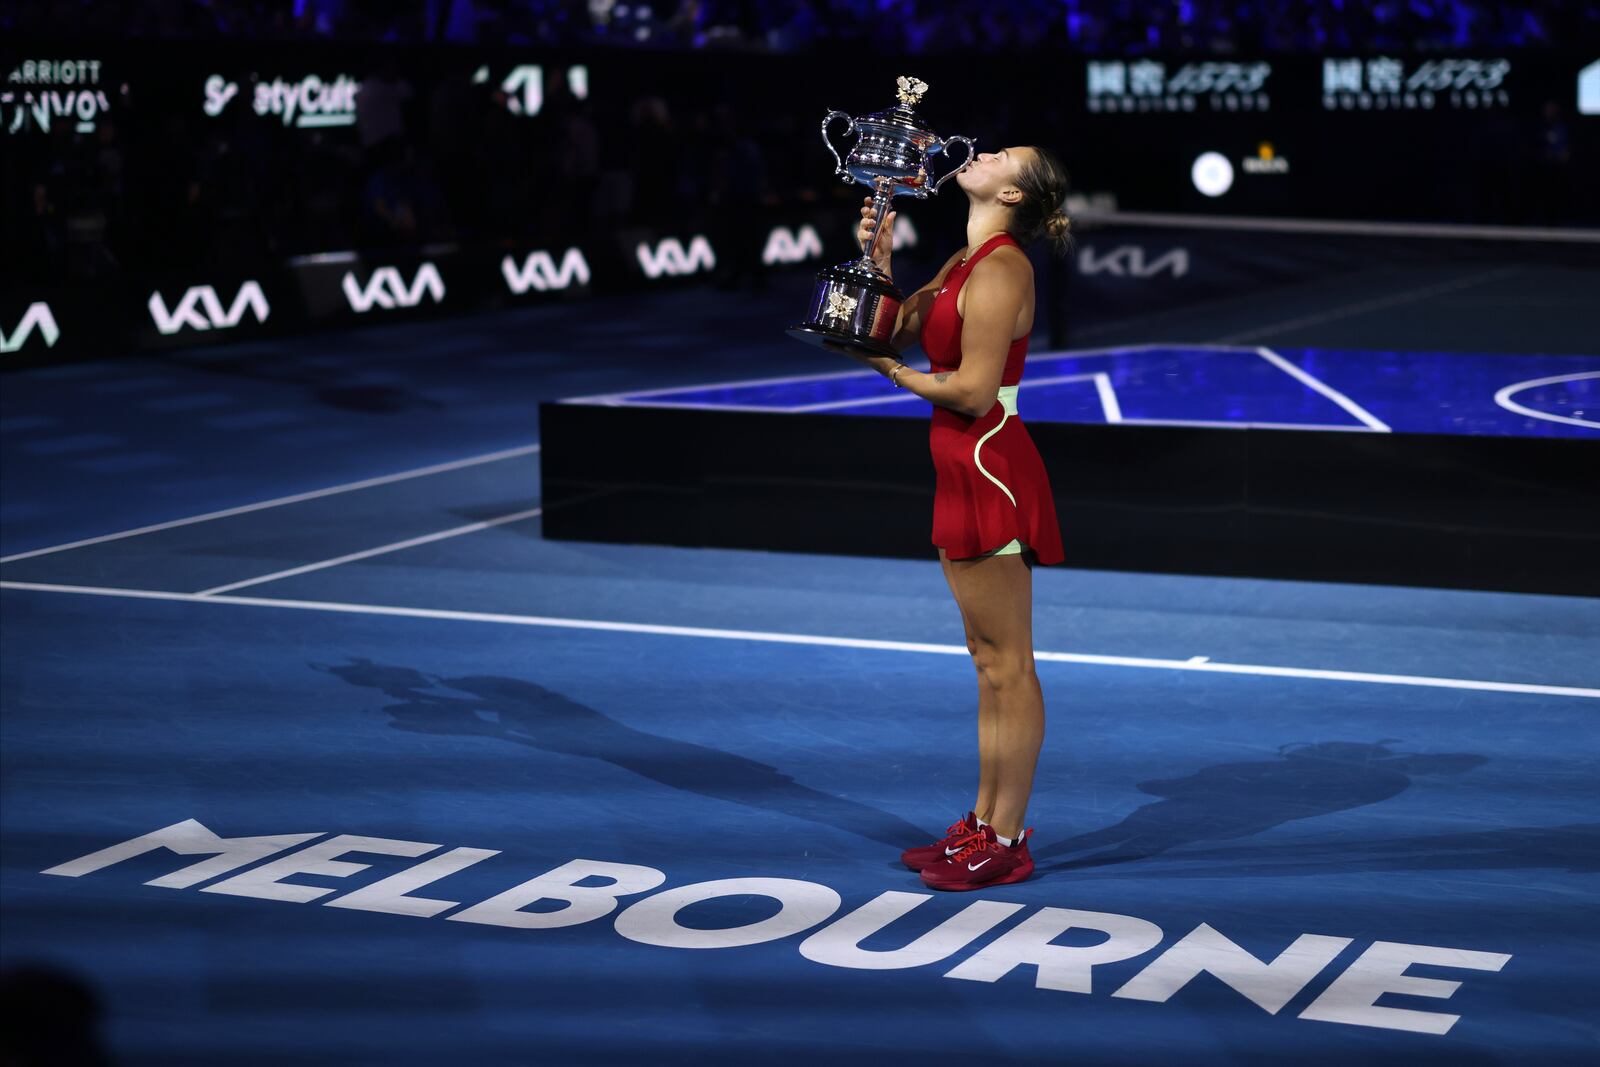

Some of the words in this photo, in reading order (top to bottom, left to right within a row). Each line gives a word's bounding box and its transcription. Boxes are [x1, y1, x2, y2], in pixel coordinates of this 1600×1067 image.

[8, 60, 101, 84] ARRIOTT
[502, 248, 590, 293] KIA
[637, 235, 715, 278] KIA
[1078, 246, 1189, 277] KIA
[148, 280, 270, 335] KIA
[343, 262, 446, 312] KIA
[40, 818, 1512, 1035] MELBOURNE
